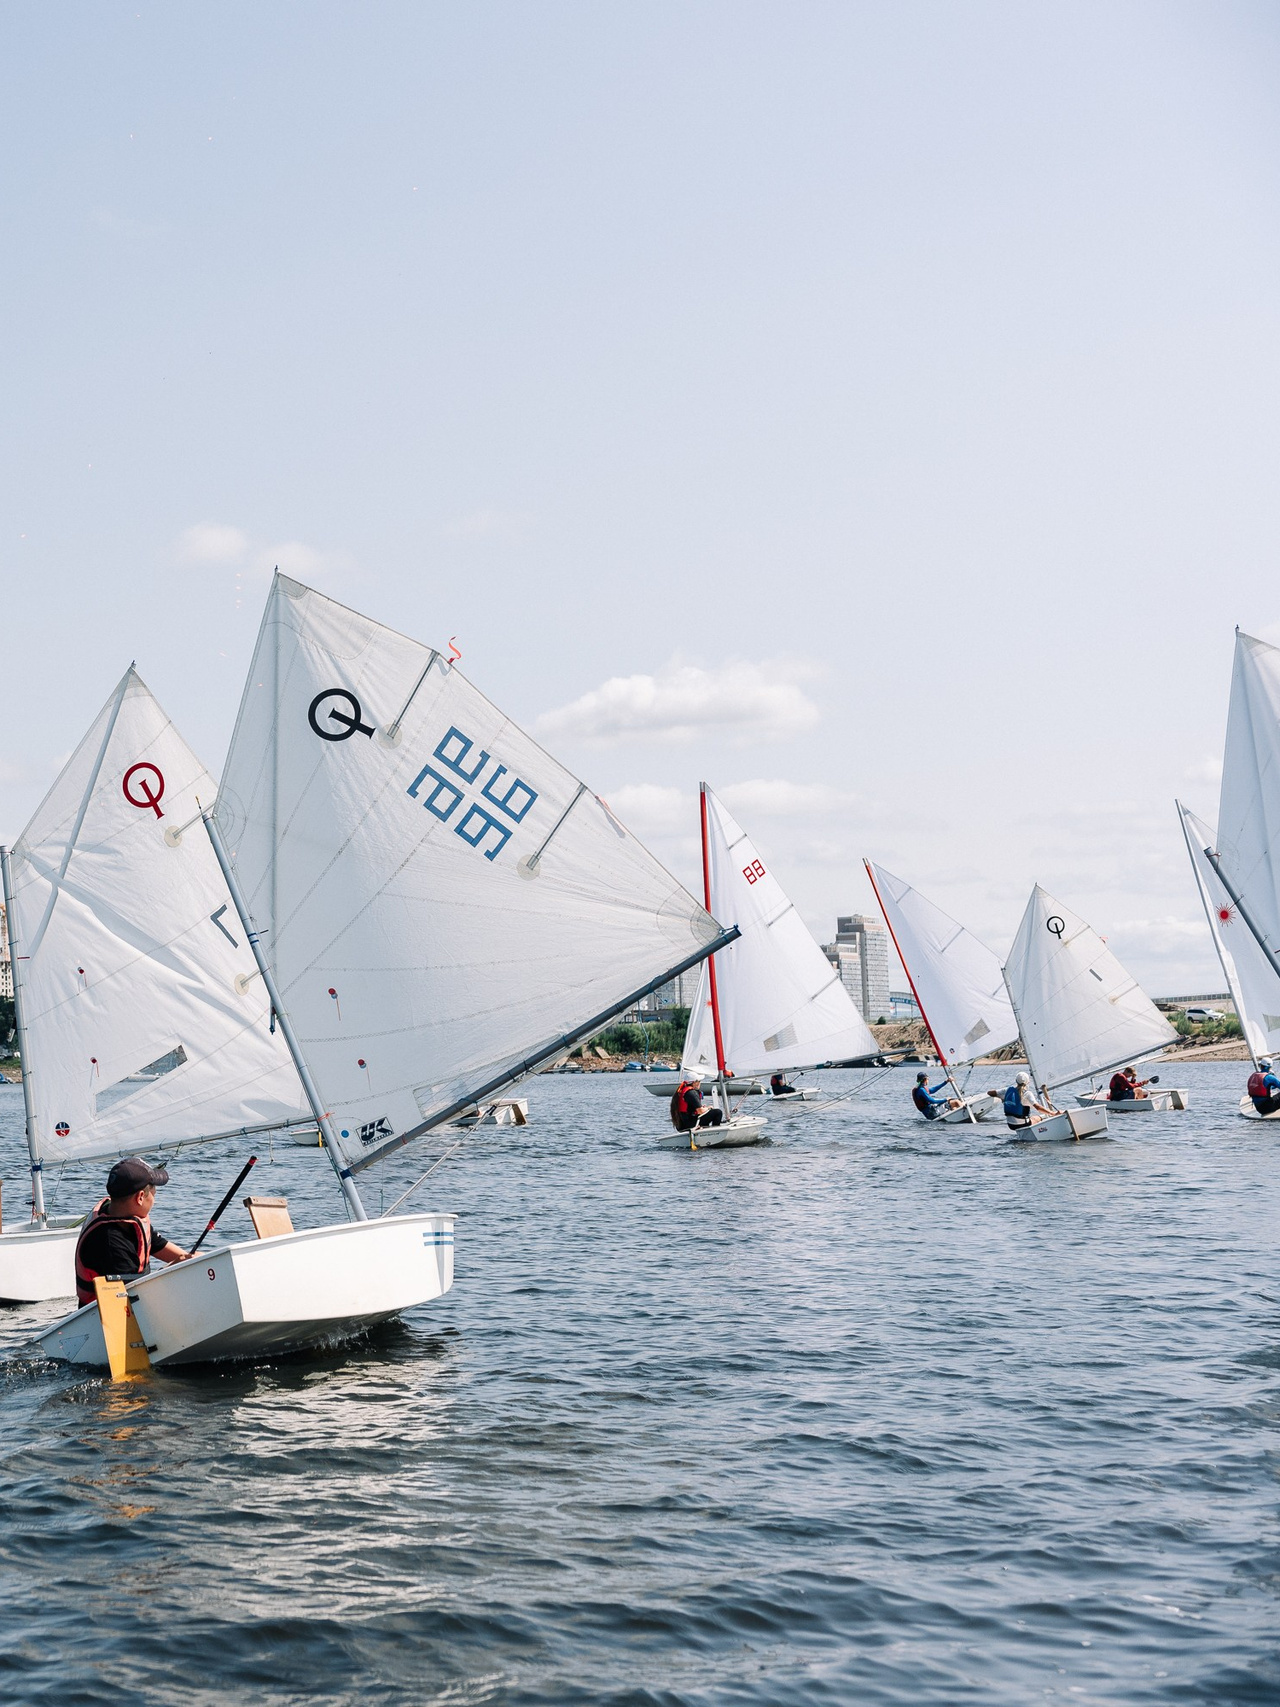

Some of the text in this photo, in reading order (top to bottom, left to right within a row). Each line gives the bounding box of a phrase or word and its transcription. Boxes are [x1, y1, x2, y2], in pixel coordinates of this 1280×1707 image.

[454, 764, 539, 862] 96
[742, 859, 766, 885] 88
[360, 1118, 392, 1141] UK
[207, 1268, 216, 1281] 9
